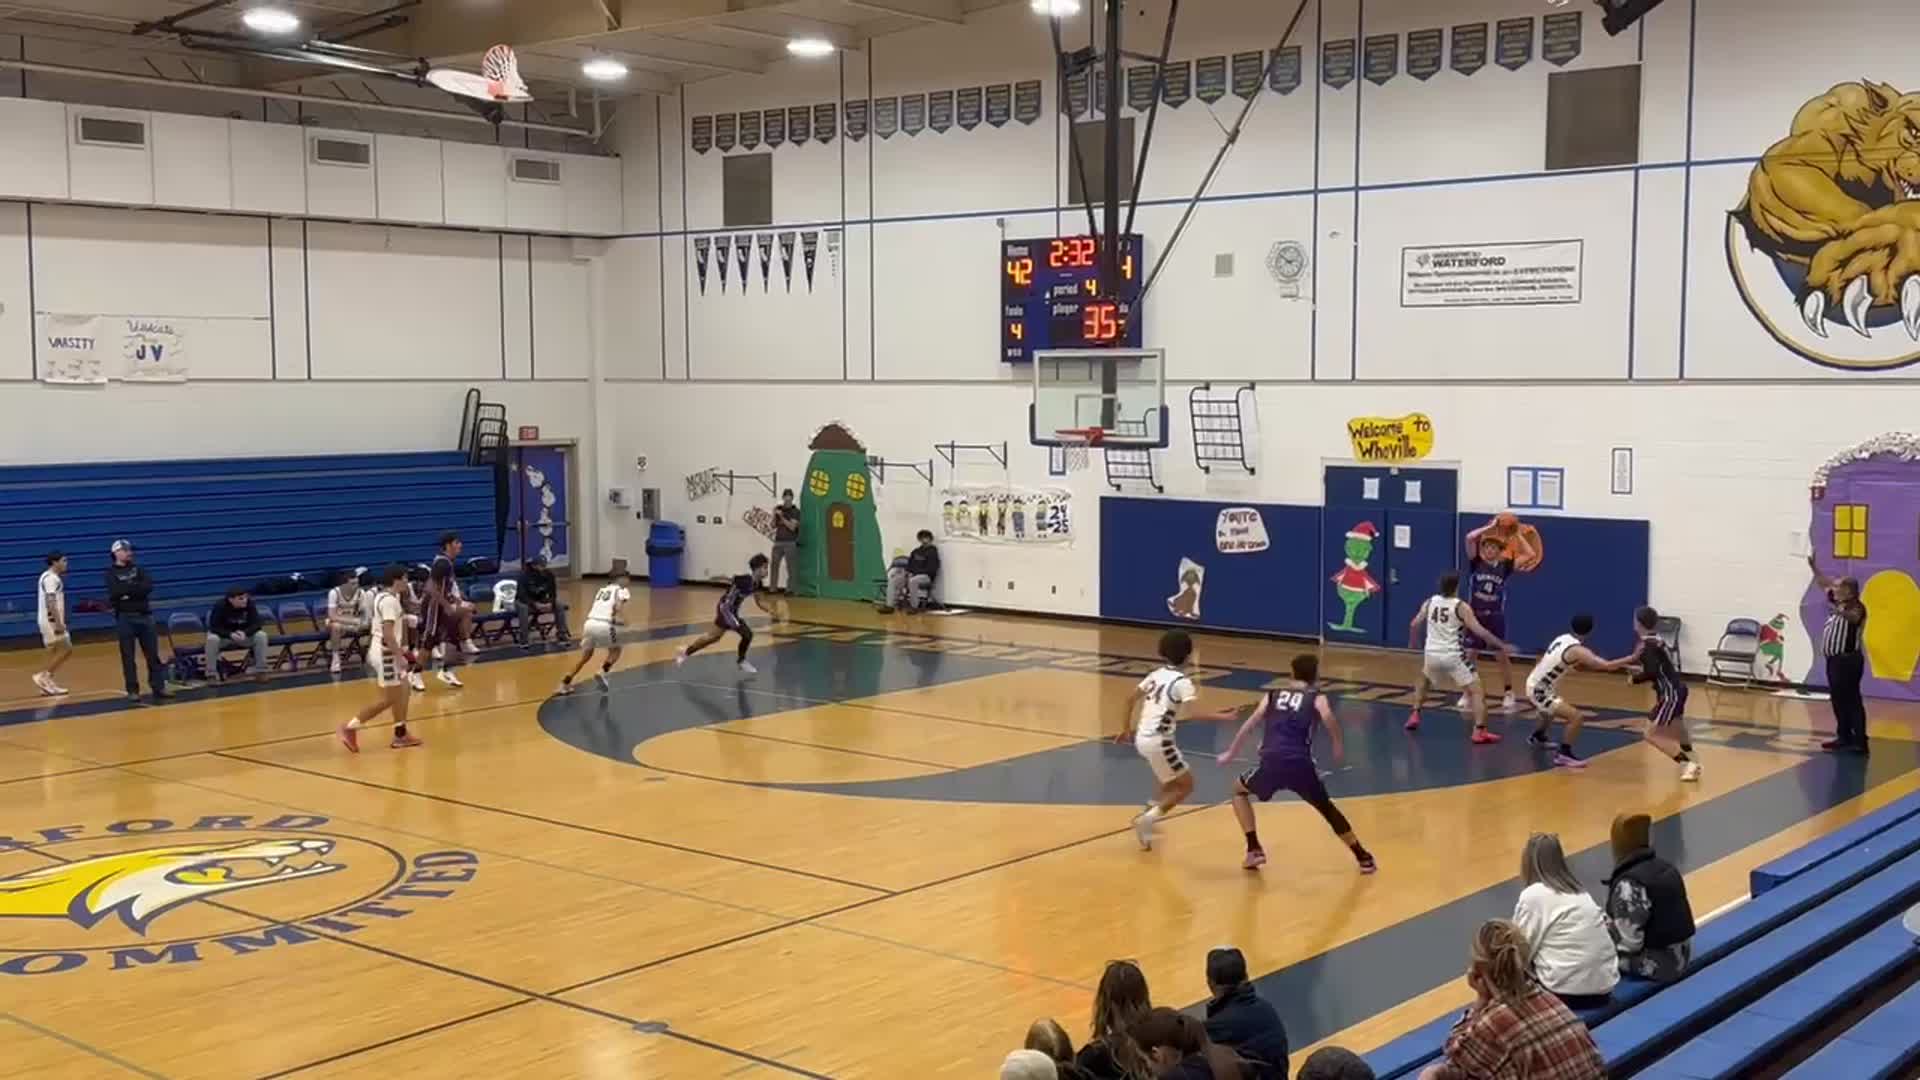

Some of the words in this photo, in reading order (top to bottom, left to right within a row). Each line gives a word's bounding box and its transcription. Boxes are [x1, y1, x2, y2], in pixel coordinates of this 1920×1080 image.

[1050, 239, 1096, 267] 2:32
[1432, 256, 1506, 268] WATERFORD
[1007, 259, 1033, 285] 42
[1085, 279, 1097, 296] 4
[1011, 323, 1022, 339] 4
[1084, 306, 1117, 339] 35
[48, 336, 96, 350] VARSITY
[1347, 422, 1403, 439] Welcome
[1050, 504, 1068, 520] 24
[1431, 606, 1450, 624] 45
[1276, 690, 1304, 712] 24
